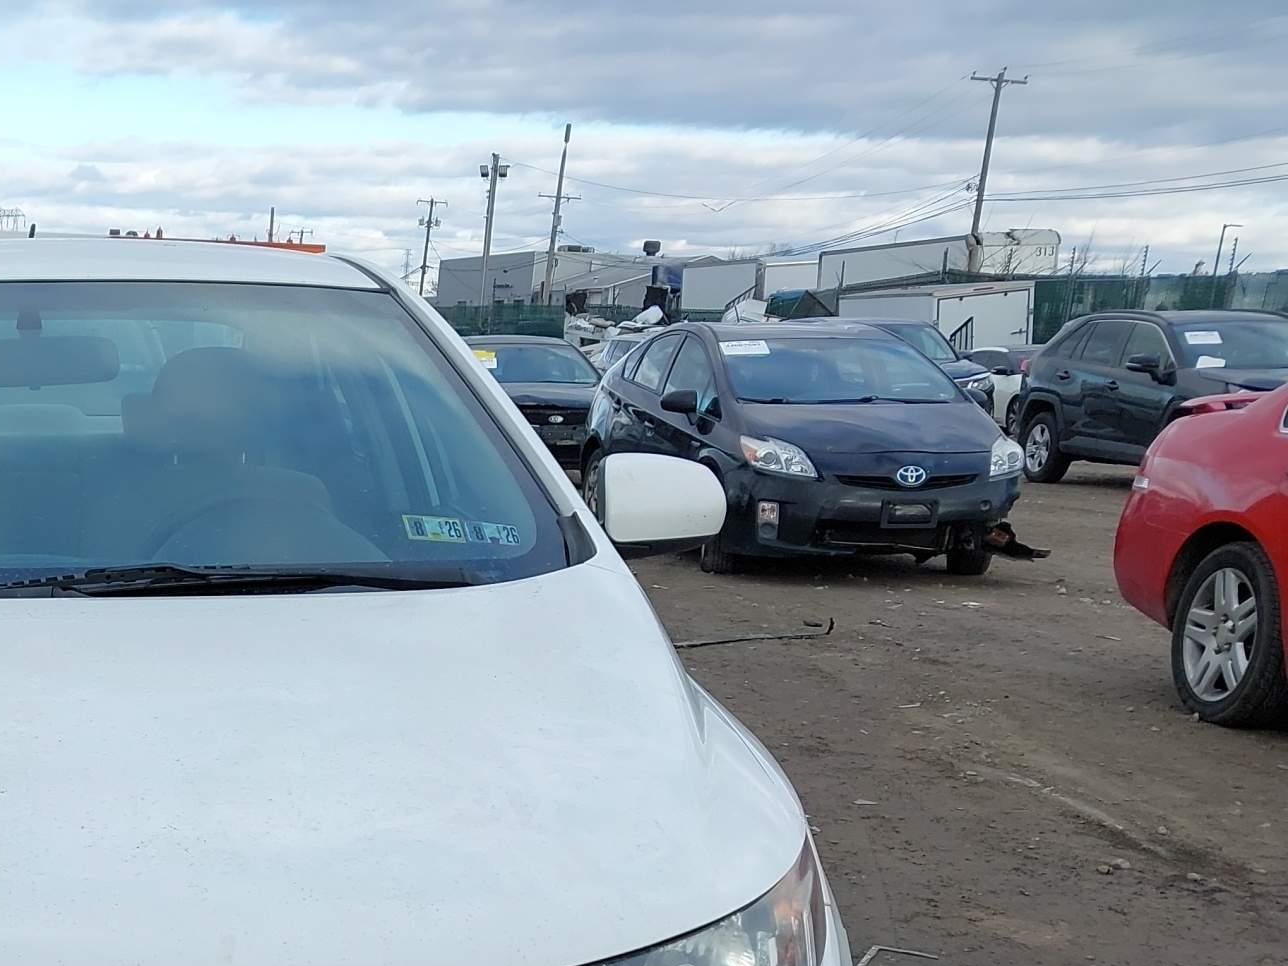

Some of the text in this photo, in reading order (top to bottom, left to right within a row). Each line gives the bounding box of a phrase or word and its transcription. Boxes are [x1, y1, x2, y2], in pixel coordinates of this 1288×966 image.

[1035, 246, 1055, 257] 313
[444, 520, 463, 539] 26
[502, 525, 520, 545] 26
